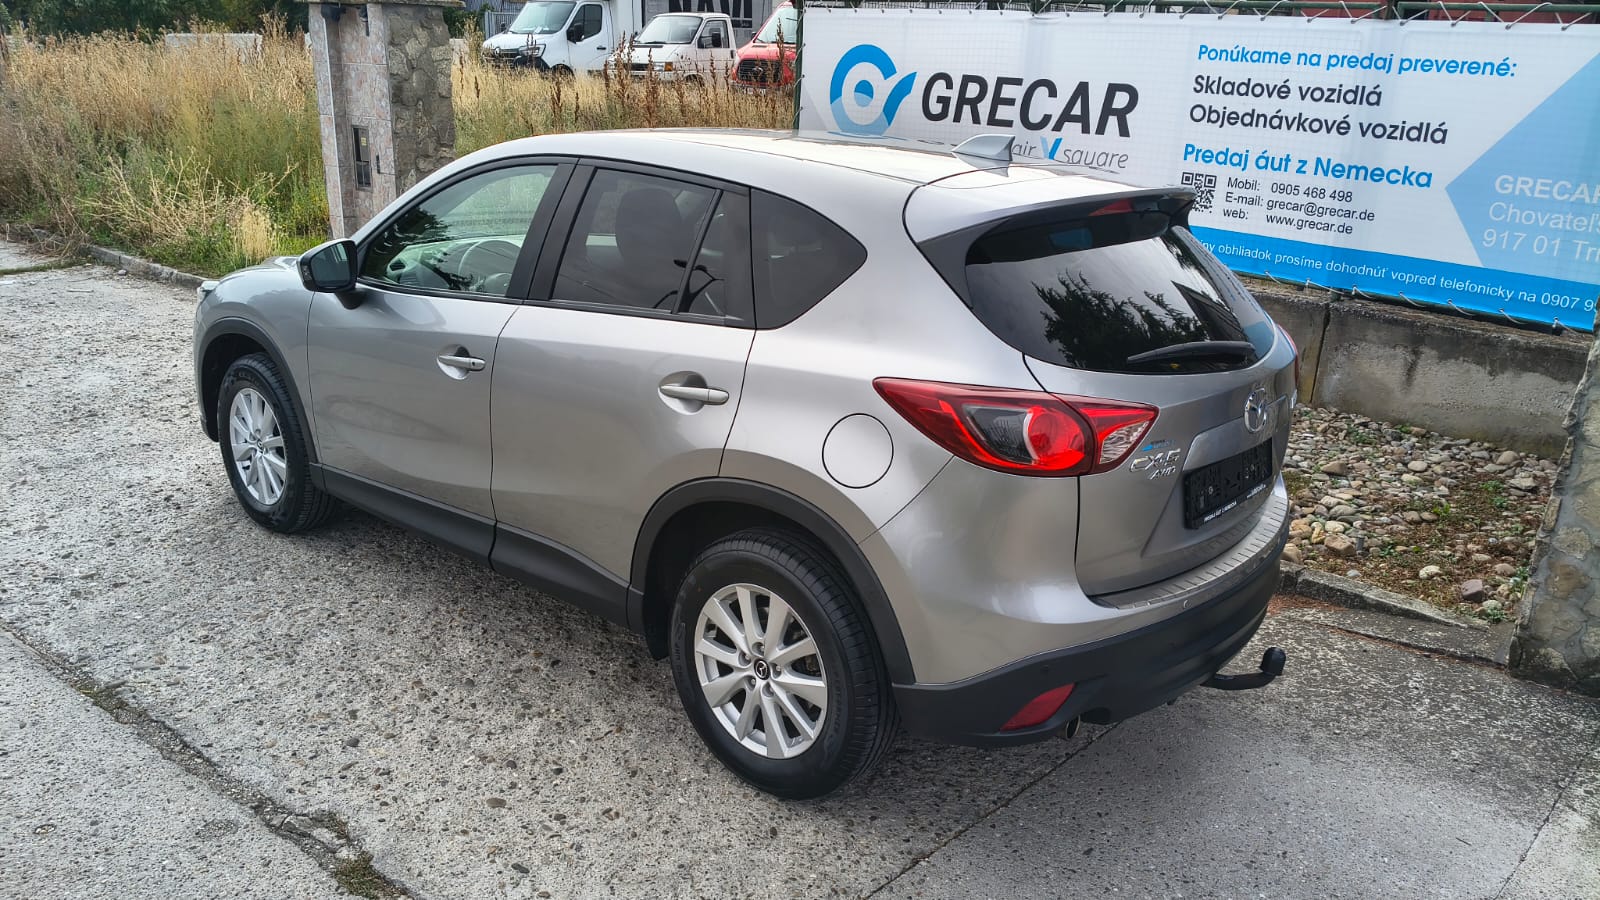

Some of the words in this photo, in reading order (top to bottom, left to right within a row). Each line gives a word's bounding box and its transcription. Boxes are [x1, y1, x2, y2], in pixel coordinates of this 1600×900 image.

[1198, 45, 1291, 64] Ponúkame
[1297, 52, 1321, 66] na
[1327, 52, 1394, 74] predaj
[1399, 56, 1517, 77] preverené:
[922, 72, 1139, 138] GRECAR
[1193, 75, 1291, 99] Skladové
[1298, 82, 1383, 106] vozidlá
[1189, 104, 1351, 136] Objednávkové
[1359, 120, 1448, 144] vozidlá
[1183, 143, 1249, 171] Predaj
[1255, 150, 1291, 172] áut
[1296, 159, 1307, 175] z
[1314, 157, 1433, 188] Nemecka
[1227, 177, 1260, 191] Mobil:
[1271, 182, 1300, 196] 0905
[1303, 186, 1326, 199] 468
[1329, 189, 1353, 203] 498
[1223, 207, 1248, 220] web:
[1266, 213, 1353, 235] www.grecar.de
[1225, 192, 1263, 207] E-mail:
[1267, 198, 1375, 222] grecar@grecar.de
[1482, 228, 1527, 251] 917
[1533, 235, 1560, 257] 01
[1218, 244, 1271, 261] obhliadok
[1275, 252, 1322, 270] prosíme
[1391, 270, 1437, 286] vopred
[1440, 276, 1514, 302] telefonicky
[1518, 290, 1536, 302] na
[1541, 292, 1580, 309] 0907
